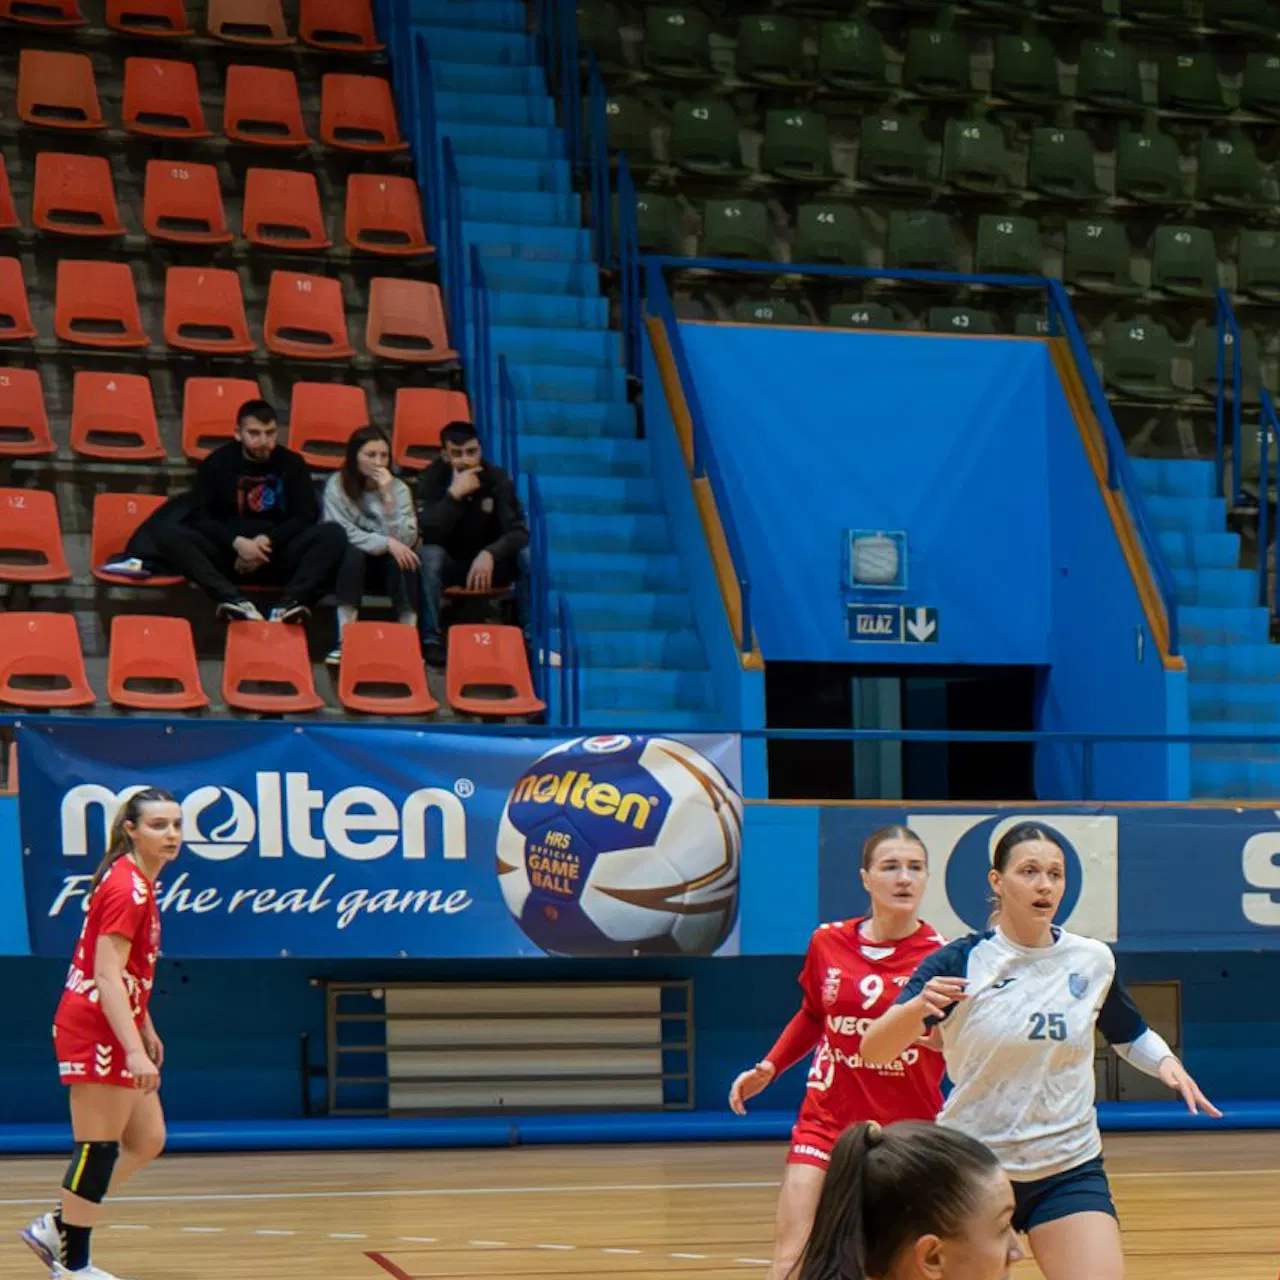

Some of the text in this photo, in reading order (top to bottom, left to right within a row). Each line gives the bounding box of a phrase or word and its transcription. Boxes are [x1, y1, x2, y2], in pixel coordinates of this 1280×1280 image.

[1087, 225, 1103, 238] 37
[856, 613, 893, 634] IZLAZ
[473, 631, 491, 645] 12
[544, 830, 571, 849] HRS
[528, 854, 580, 879] GAME
[531, 870, 575, 895] BALL
[227, 873, 334, 914] real
[330, 888, 473, 929] game
[859, 973, 884, 1010] 9
[1028, 1012, 1068, 1041] 25
